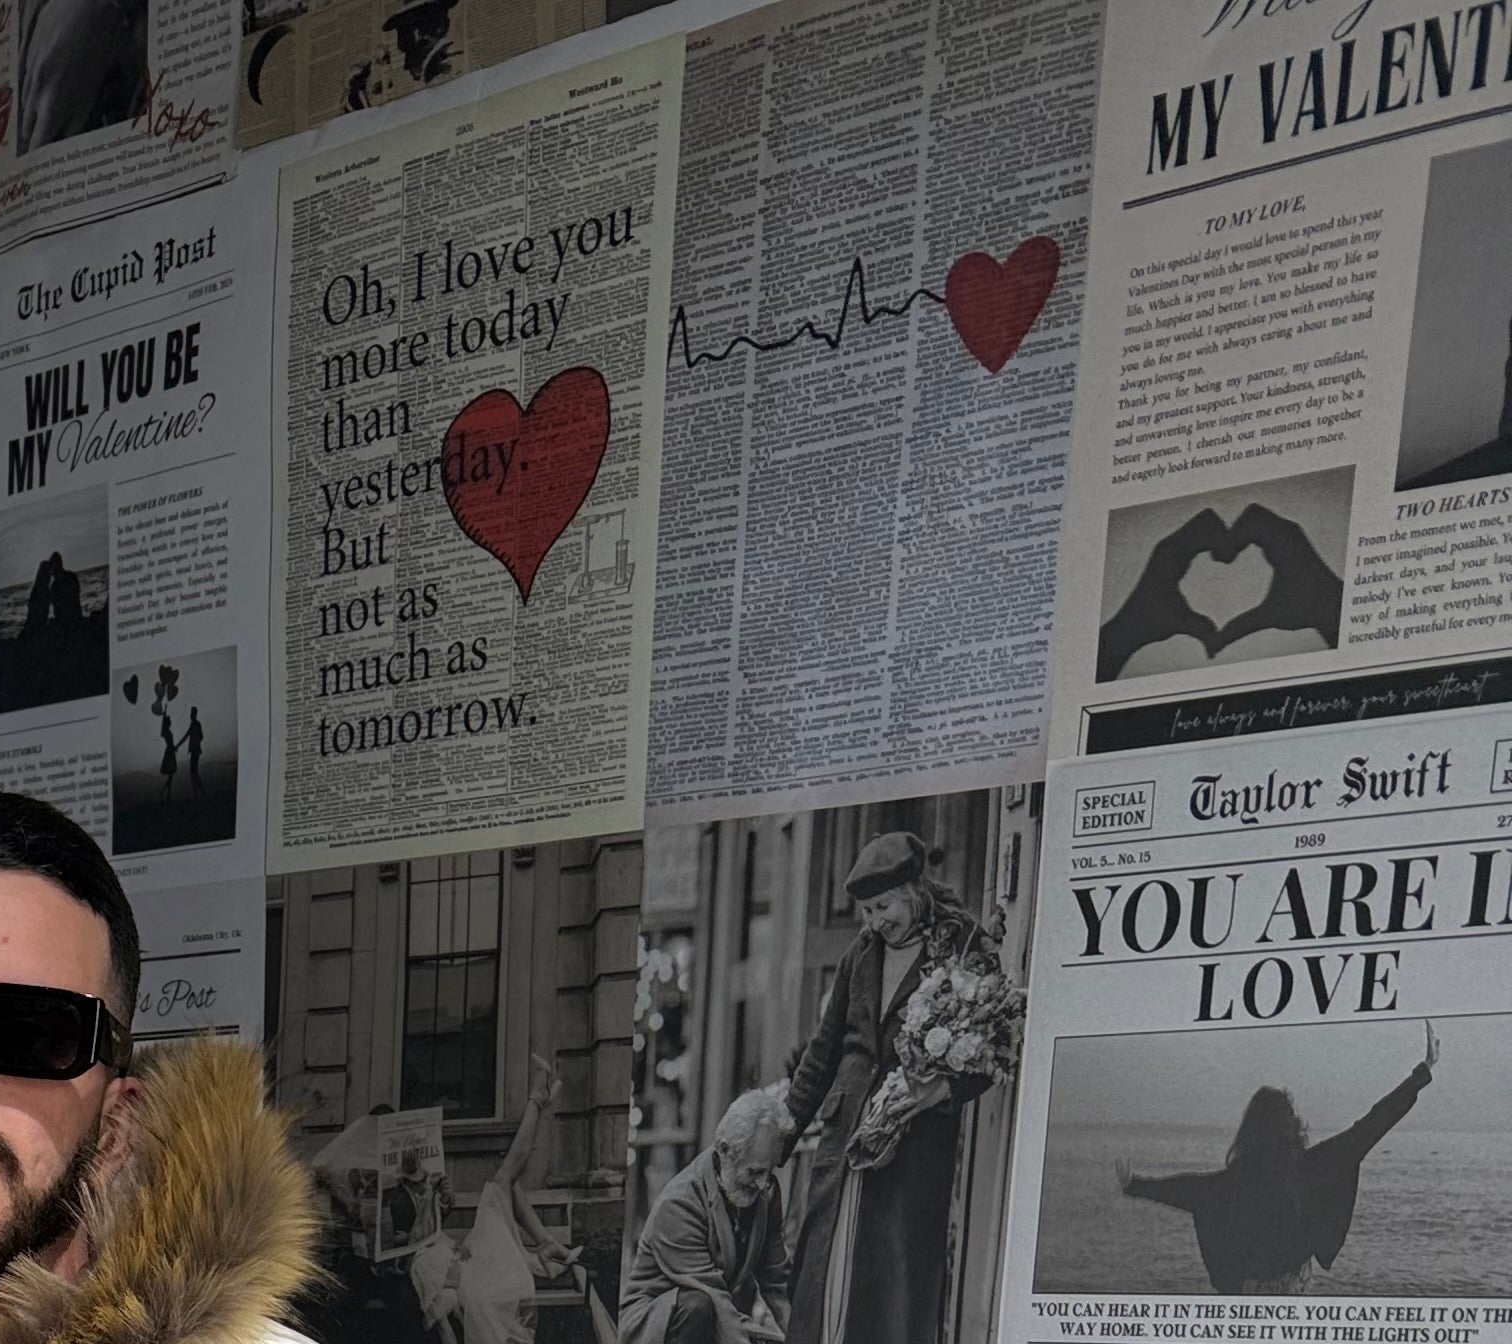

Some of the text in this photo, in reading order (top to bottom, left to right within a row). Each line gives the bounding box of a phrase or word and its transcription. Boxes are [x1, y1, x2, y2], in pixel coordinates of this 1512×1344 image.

[1146, 73, 1234, 175] MY
[1205, 194, 1307, 235] TO MY LOVE,
[17, 225, 217, 322] The Cupid Post
[323, 206, 635, 326] Oh, I love you
[320, 289, 571, 392] more today
[25, 321, 201, 432] WILL YOU BE
[8, 392, 216, 496] MY Valentine?
[321, 398, 412, 453] than
[320, 431, 528, 526] yesterday.
[319, 523, 390, 578] But
[319, 582, 438, 638] not as
[318, 632, 487, 697] much as
[318, 692, 536, 757] tomorrow.
[1081, 790, 1147, 811] SPECIAL
[1189, 748, 1453, 825] Taylor Swift
[1081, 809, 1145, 831] EDITION
[1294, 833, 1326, 850] 1989
[1071, 854, 1438, 958] YOU ARE
[157, 979, 217, 1017] Post
[1193, 949, 1401, 1023] LOVE
[1059, 1321, 1480, 1344] WAY HOME. YOU CAN SEE IT WITH THE LIGHTS OUT"
